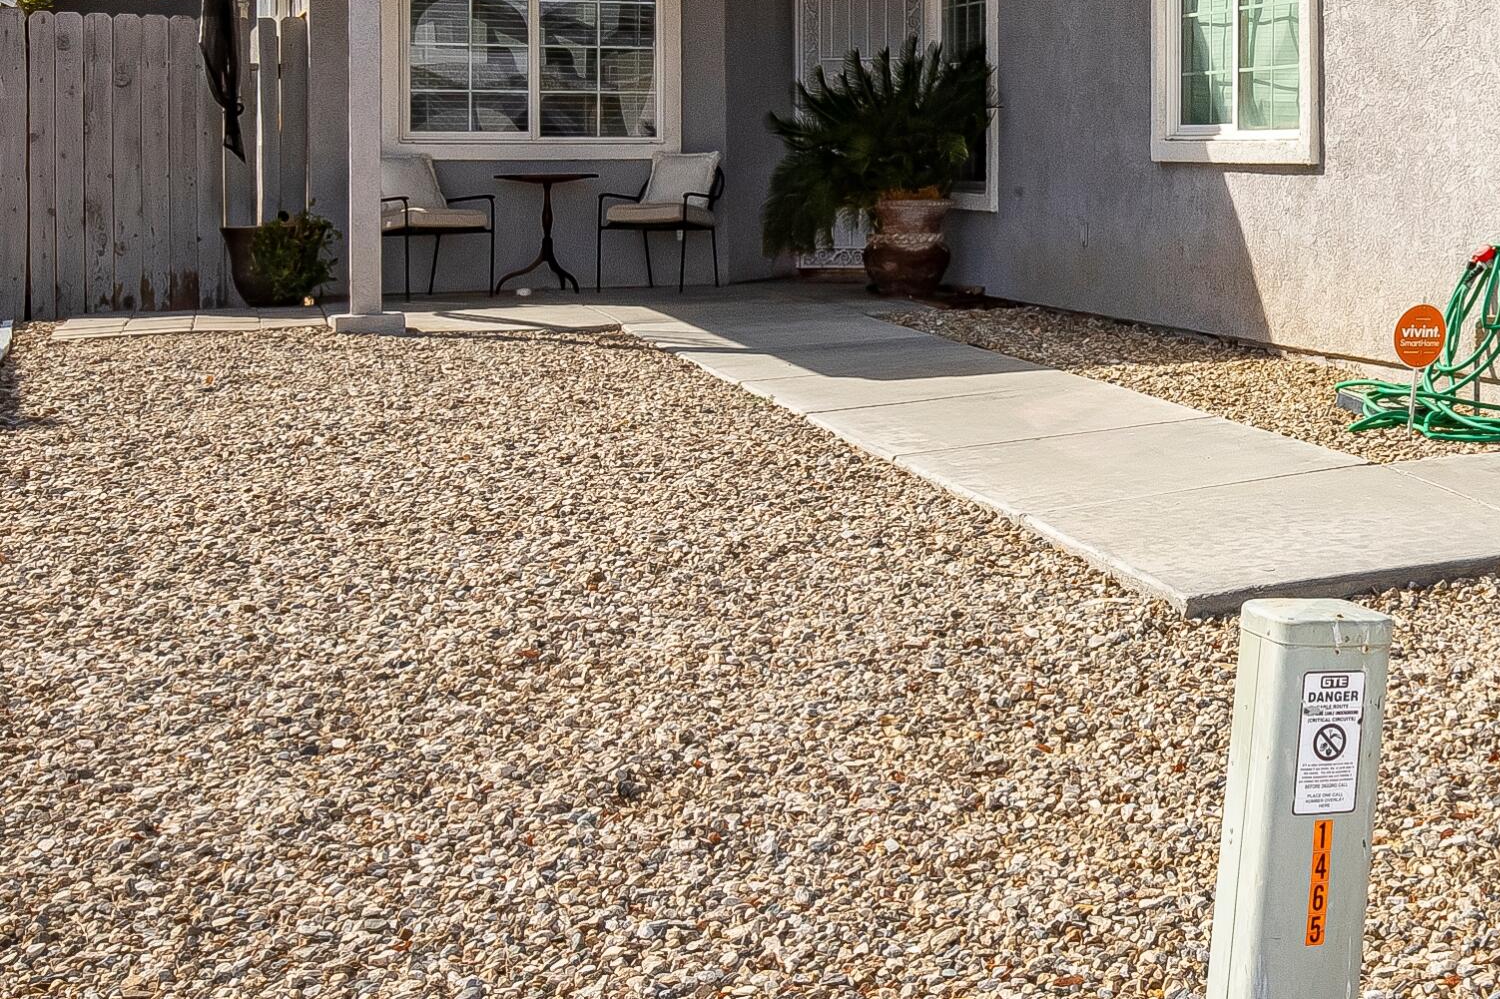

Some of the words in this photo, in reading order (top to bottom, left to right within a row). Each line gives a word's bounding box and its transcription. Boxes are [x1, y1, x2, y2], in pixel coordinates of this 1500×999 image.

[1401, 324, 1441, 338] vivint.
[1321, 676, 1349, 688] GTE
[1308, 690, 1358, 702] DANGER
[1309, 821, 1327, 943] 1465
